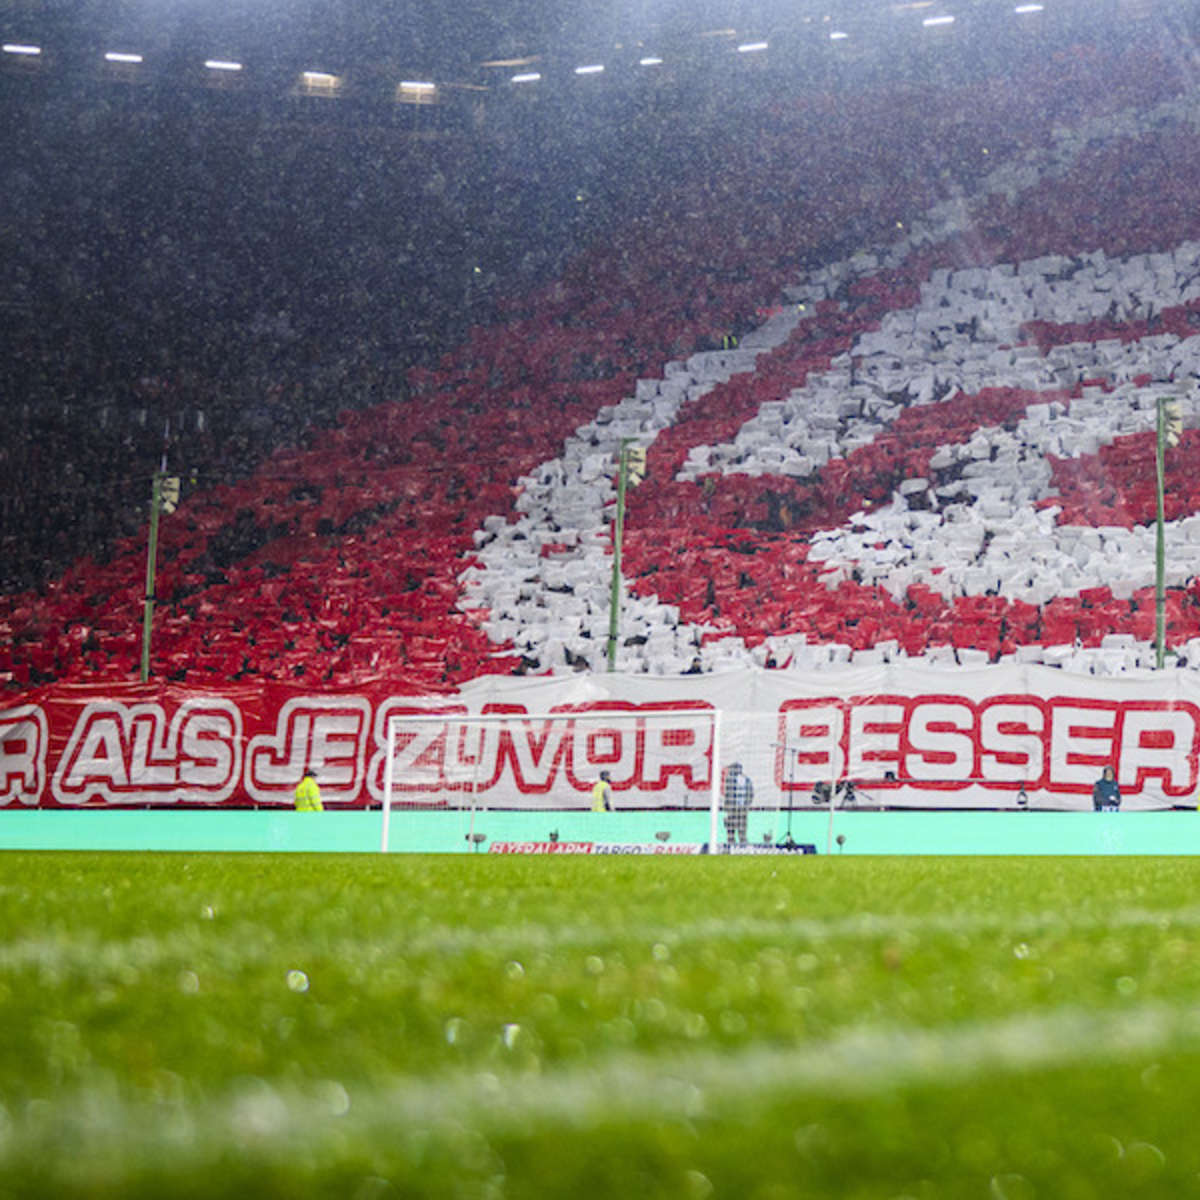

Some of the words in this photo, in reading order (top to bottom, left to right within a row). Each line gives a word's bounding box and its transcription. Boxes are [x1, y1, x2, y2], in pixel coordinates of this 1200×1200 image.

[58, 707, 238, 794] ALS
[249, 705, 364, 793] JE
[378, 702, 714, 793] ZUVOR
